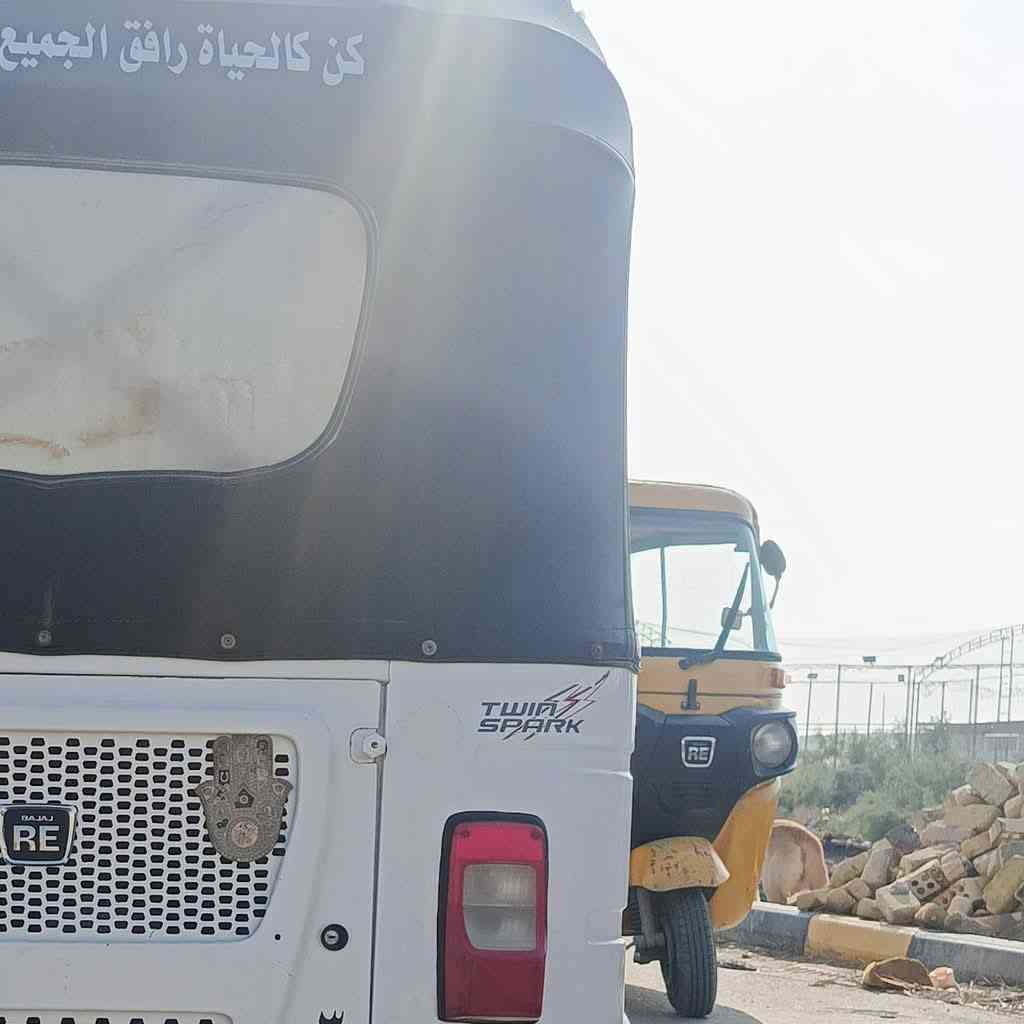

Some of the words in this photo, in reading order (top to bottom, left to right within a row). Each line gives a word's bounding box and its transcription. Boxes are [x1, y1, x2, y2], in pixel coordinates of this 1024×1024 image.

[119, 19, 188, 74] رافق
[197, 23, 310, 80] كالحياة
[323, 33, 363, 86] كن
[477, 718, 585, 733] SPARK
[688, 746, 710, 761] RE
[13, 825, 60, 851] RE
